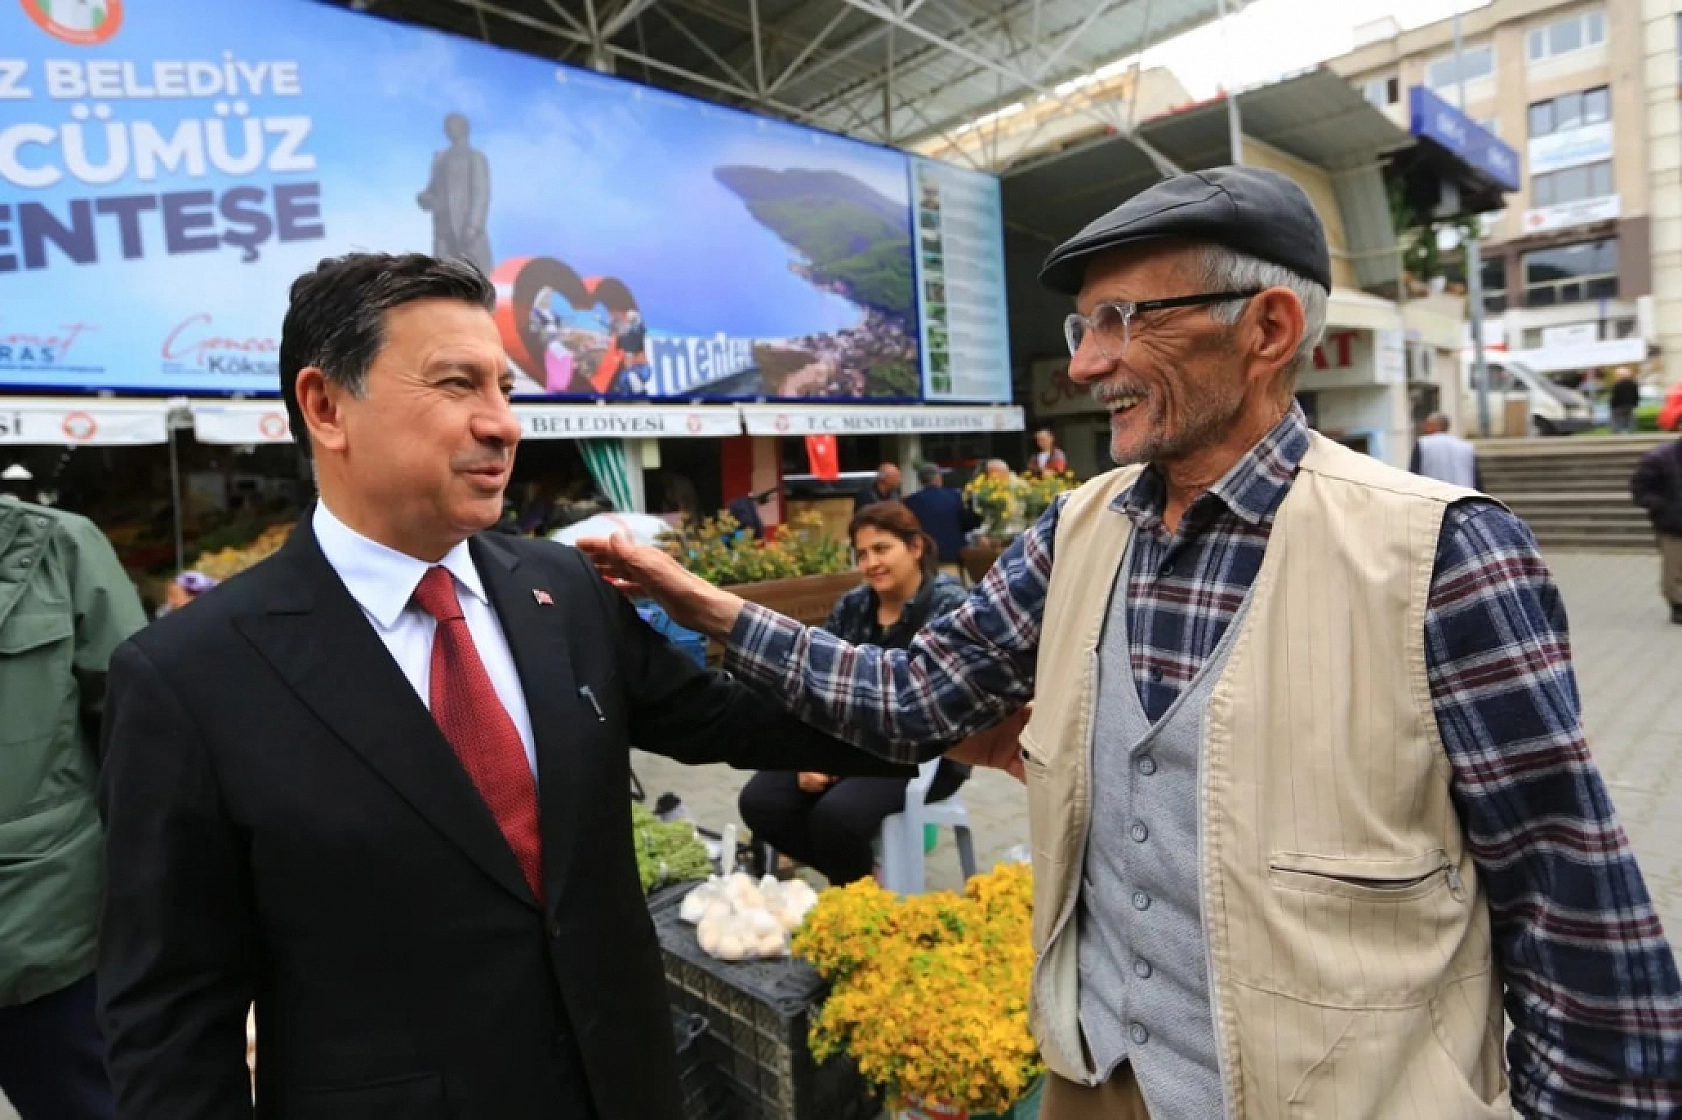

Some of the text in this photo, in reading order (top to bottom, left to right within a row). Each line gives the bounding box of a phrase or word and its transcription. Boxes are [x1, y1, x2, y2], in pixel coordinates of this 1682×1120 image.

[45, 51, 302, 98] BELEDİYE
[0, 101, 317, 188] CÜMÜZ
[532, 412, 666, 432] BELEDİYESİ
